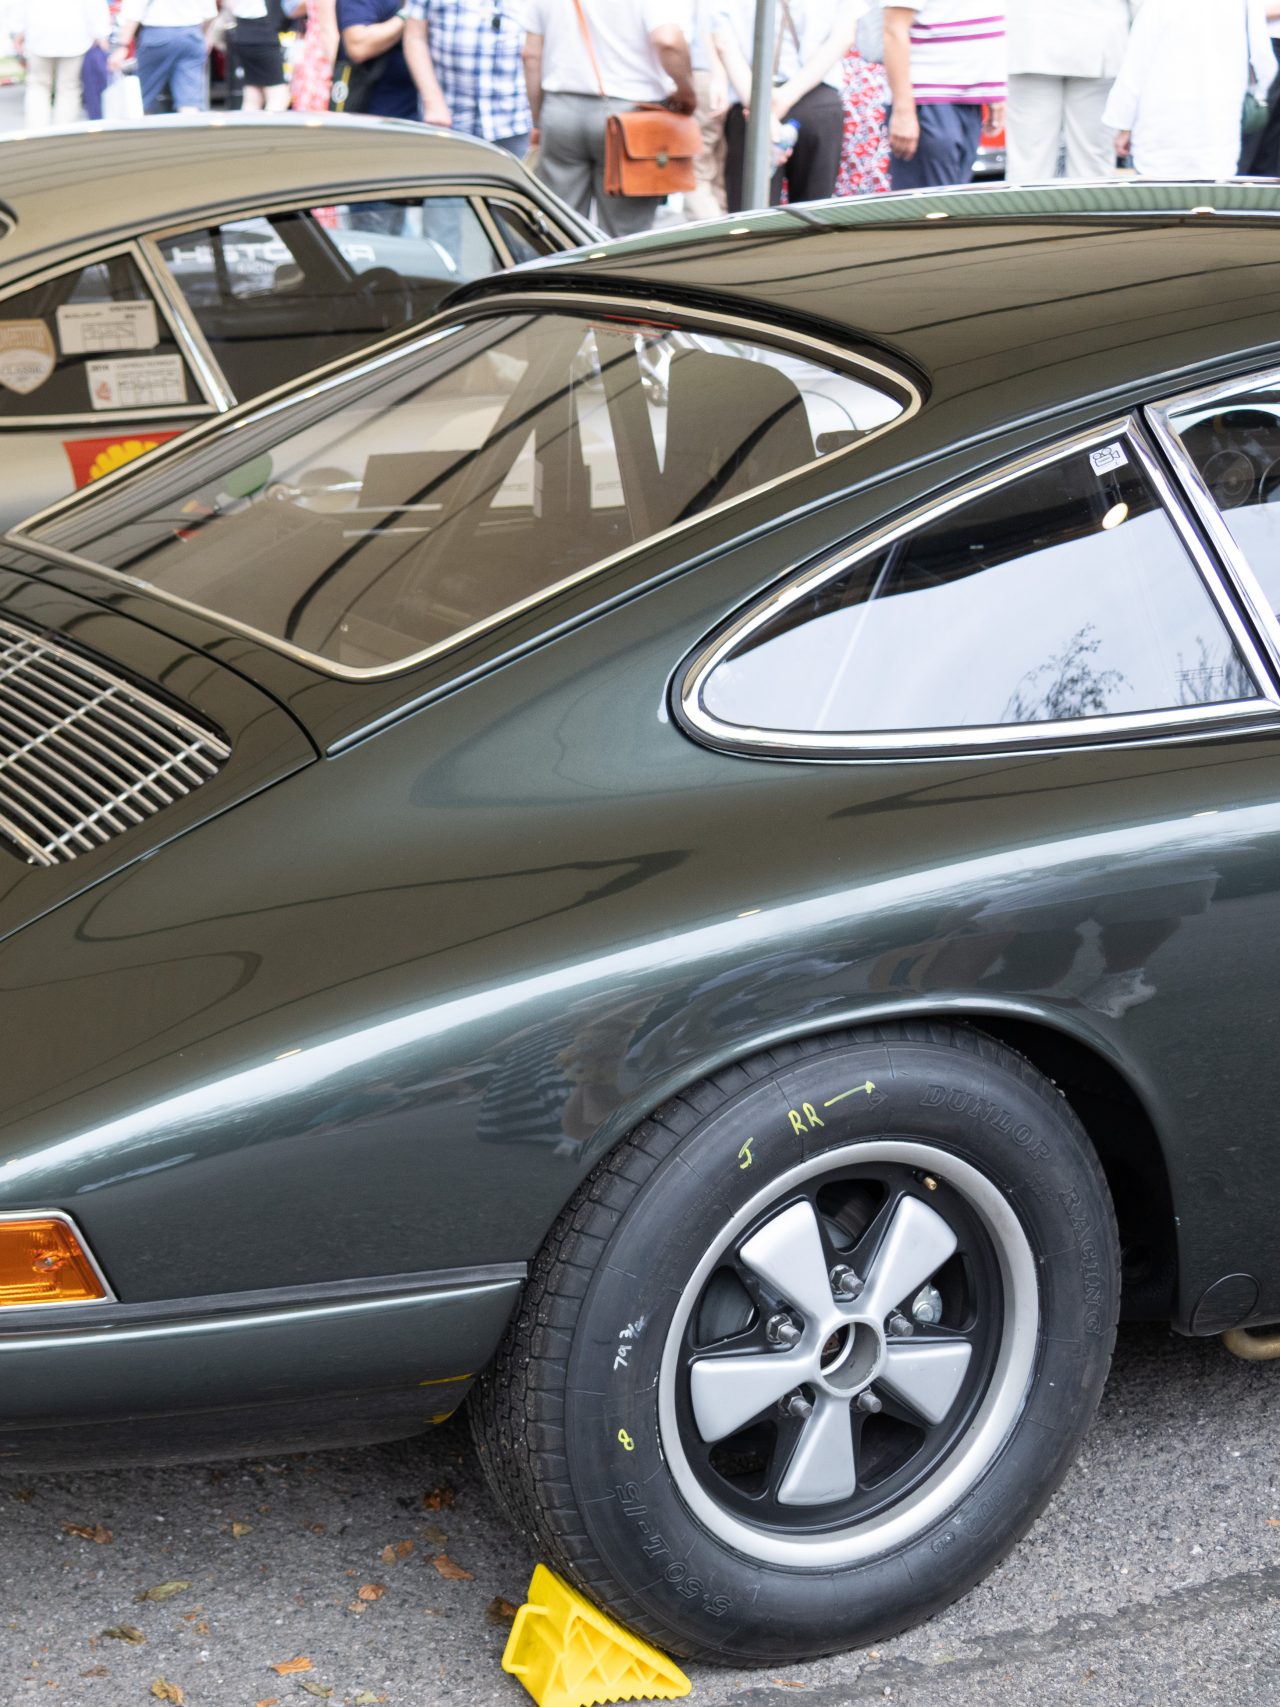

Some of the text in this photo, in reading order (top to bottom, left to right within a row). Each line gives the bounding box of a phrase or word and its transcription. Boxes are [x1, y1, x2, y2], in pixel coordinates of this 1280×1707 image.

[788, 1102, 825, 1135] RR
[921, 1083, 1104, 1337] DUNLOP RACING
[618, 1428, 634, 1451] 8
